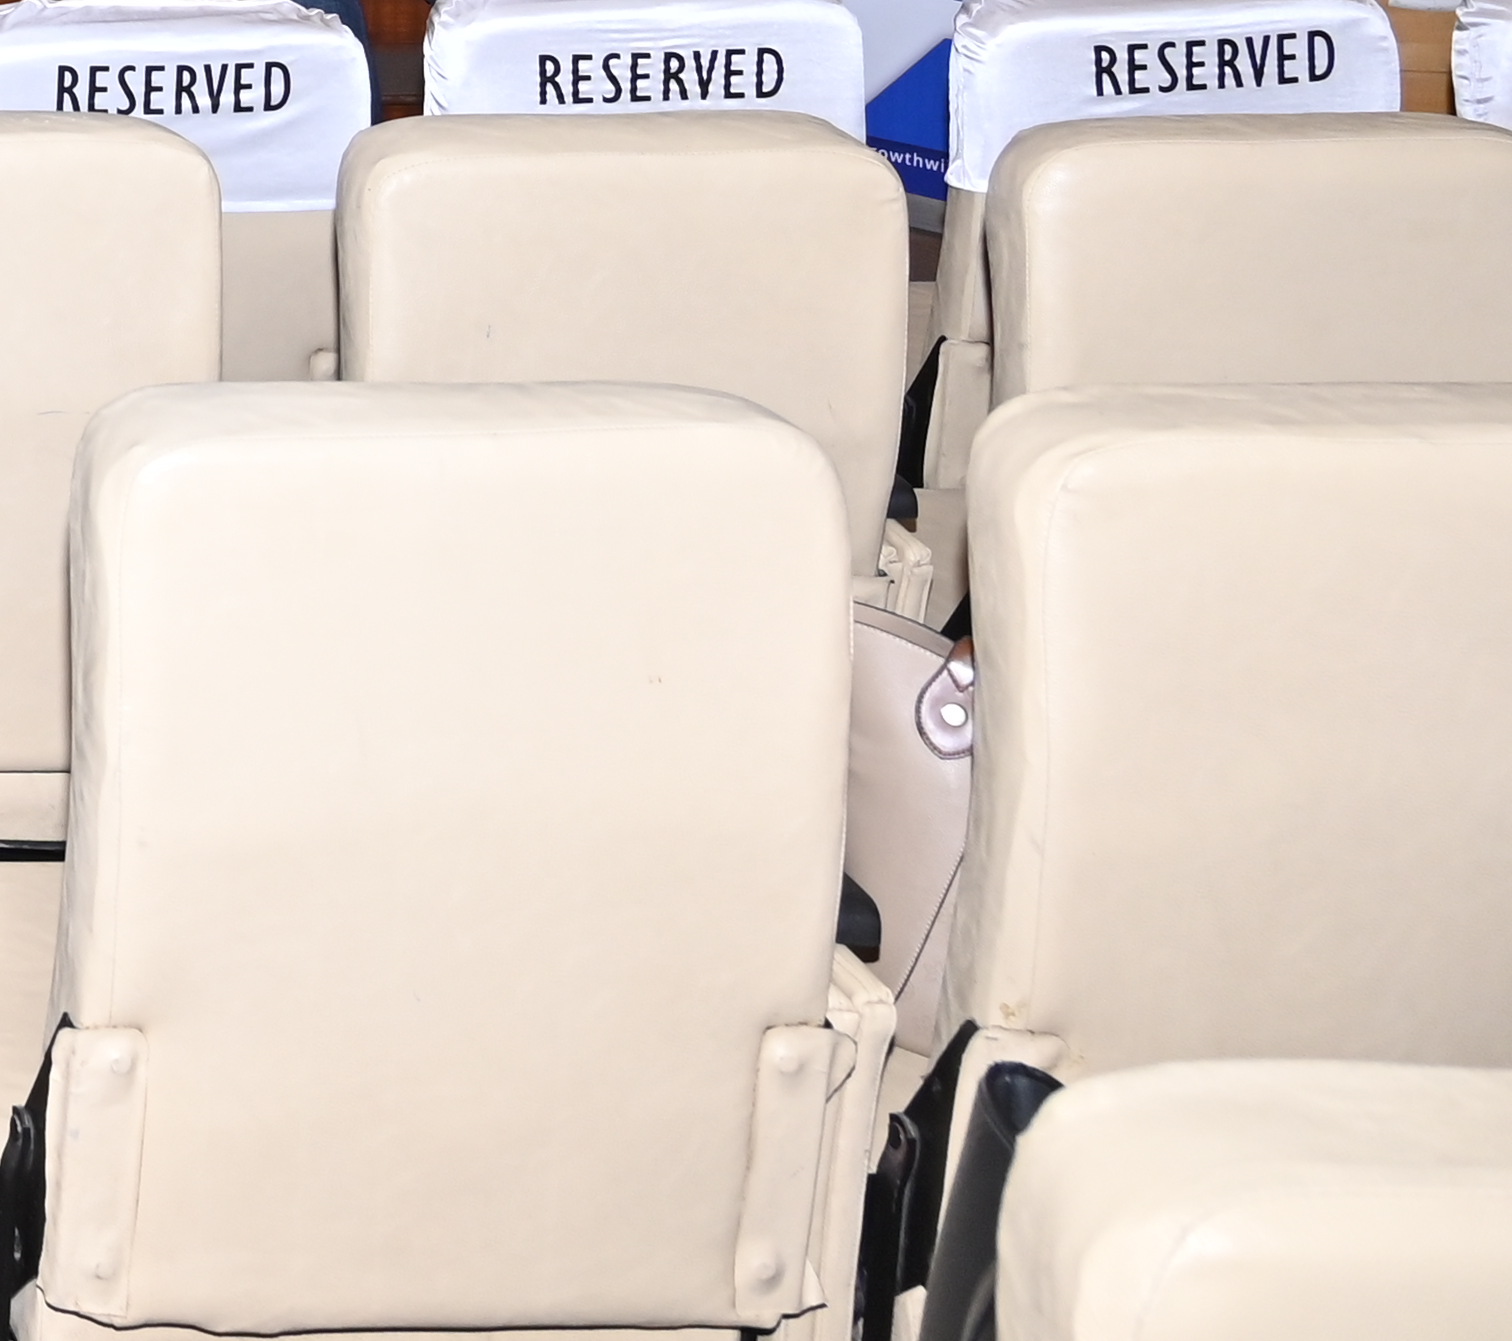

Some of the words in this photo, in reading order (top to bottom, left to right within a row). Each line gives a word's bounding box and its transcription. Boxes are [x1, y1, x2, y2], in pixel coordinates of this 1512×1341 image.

[55, 60, 293, 115] RESERVED
[537, 46, 787, 107] RESERVED
[1094, 28, 1335, 98] RESERVED
